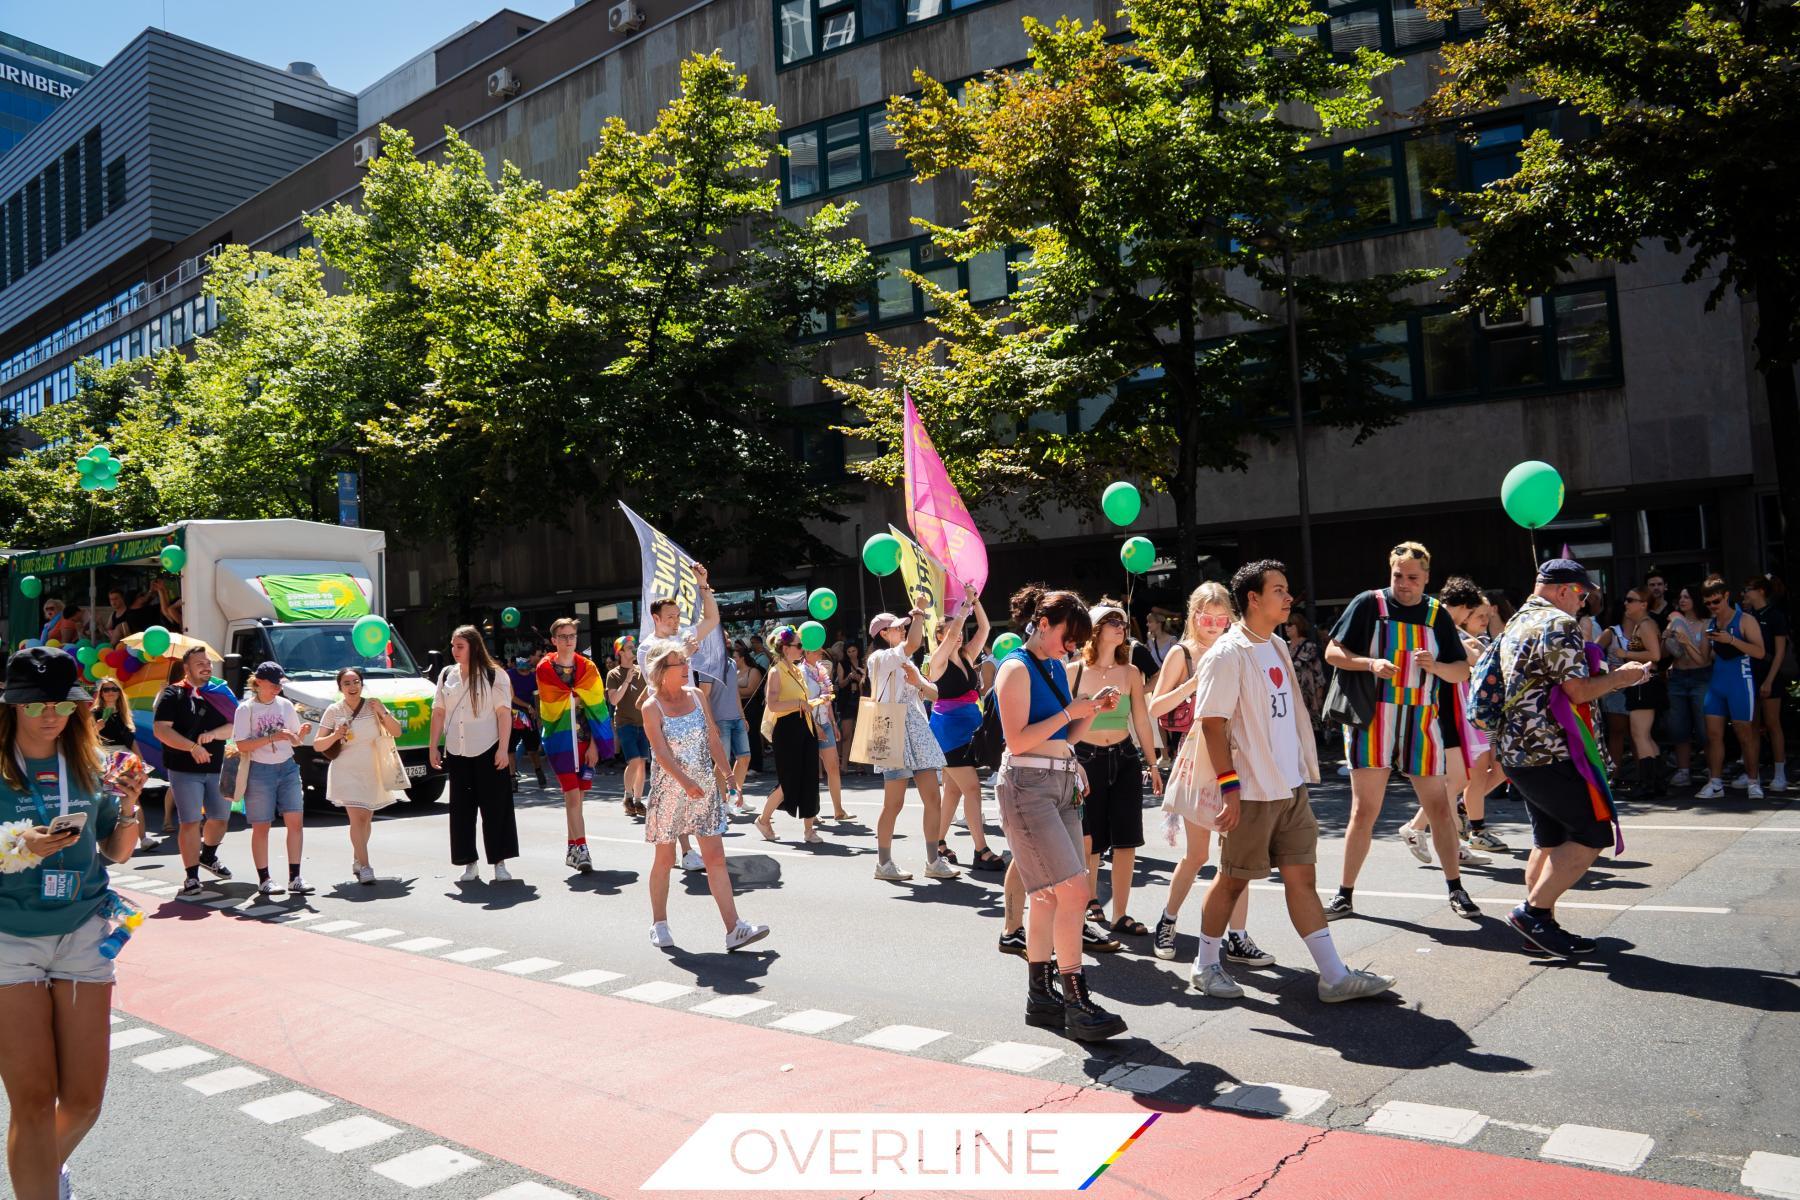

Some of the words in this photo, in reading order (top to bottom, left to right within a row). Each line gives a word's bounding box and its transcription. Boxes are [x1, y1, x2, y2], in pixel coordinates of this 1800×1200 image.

[69, 550, 85, 568] LOVE
[92, 545, 108, 564] LOVE
[122, 540, 141, 559] LOVE
[21, 558, 35, 574] LOVE
[41, 554, 56, 571] LOVE
[57, 873, 67, 898] TRUCK
